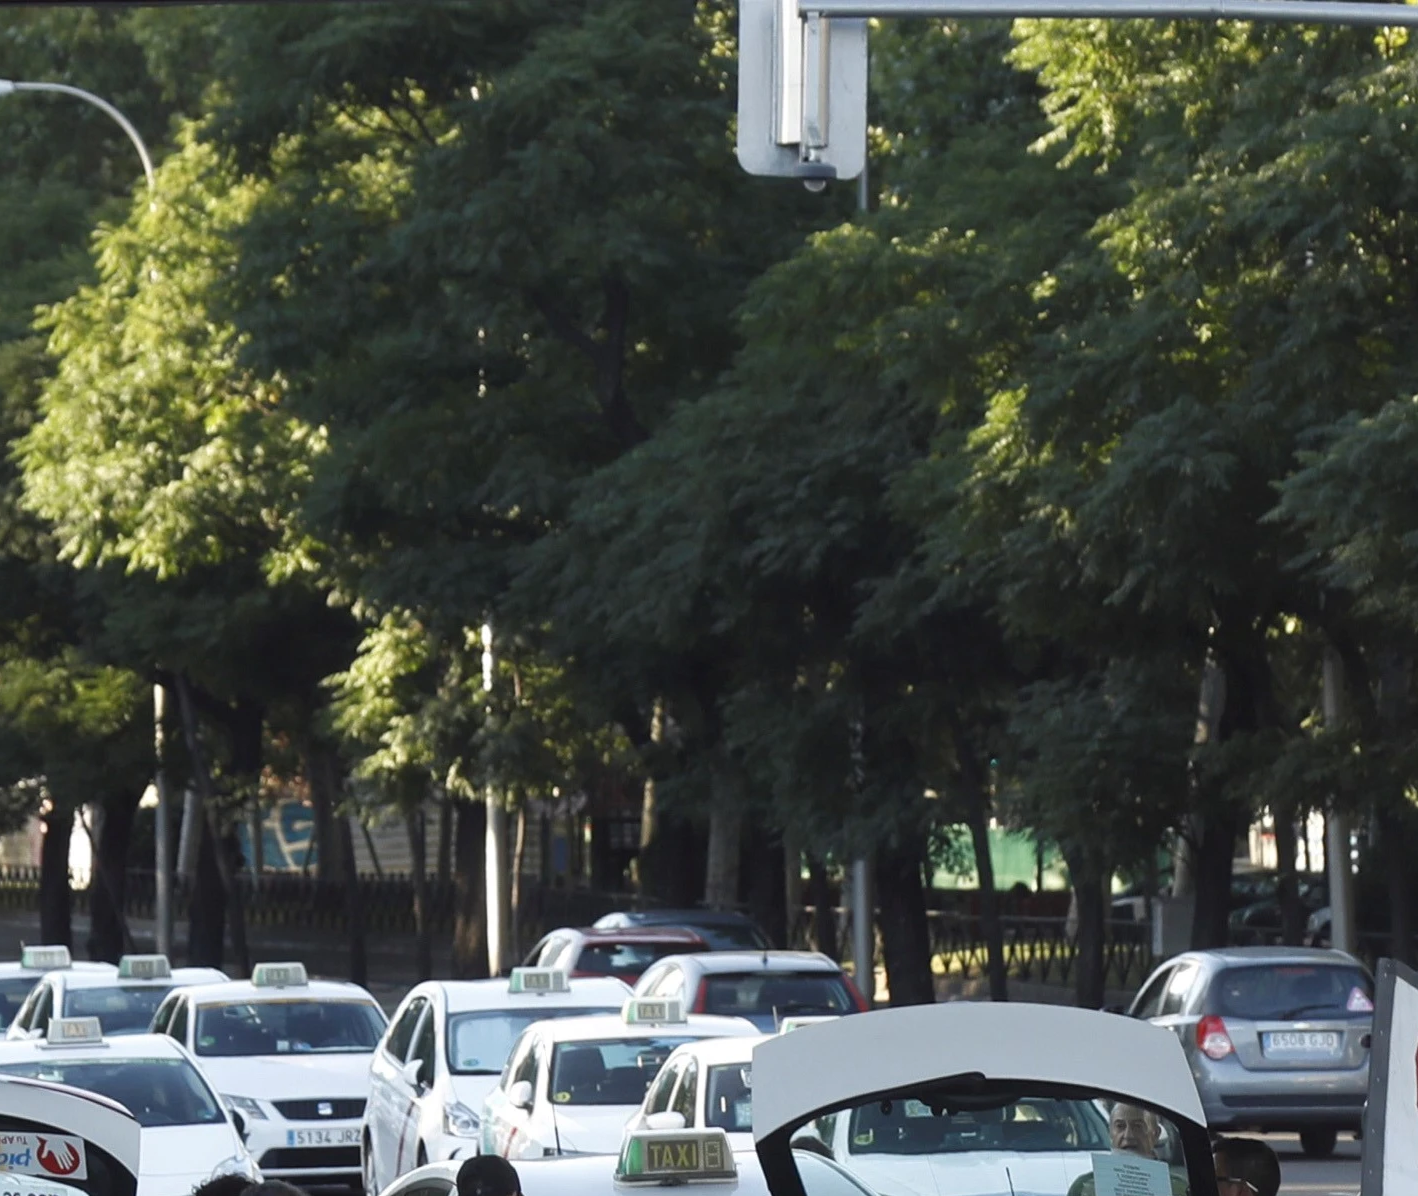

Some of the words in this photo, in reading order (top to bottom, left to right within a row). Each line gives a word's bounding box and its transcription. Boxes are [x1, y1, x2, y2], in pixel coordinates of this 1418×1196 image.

[525, 974, 549, 987] TAXI
[639, 1004, 665, 1018] TAXI
[651, 1142, 698, 1169] TAXI
